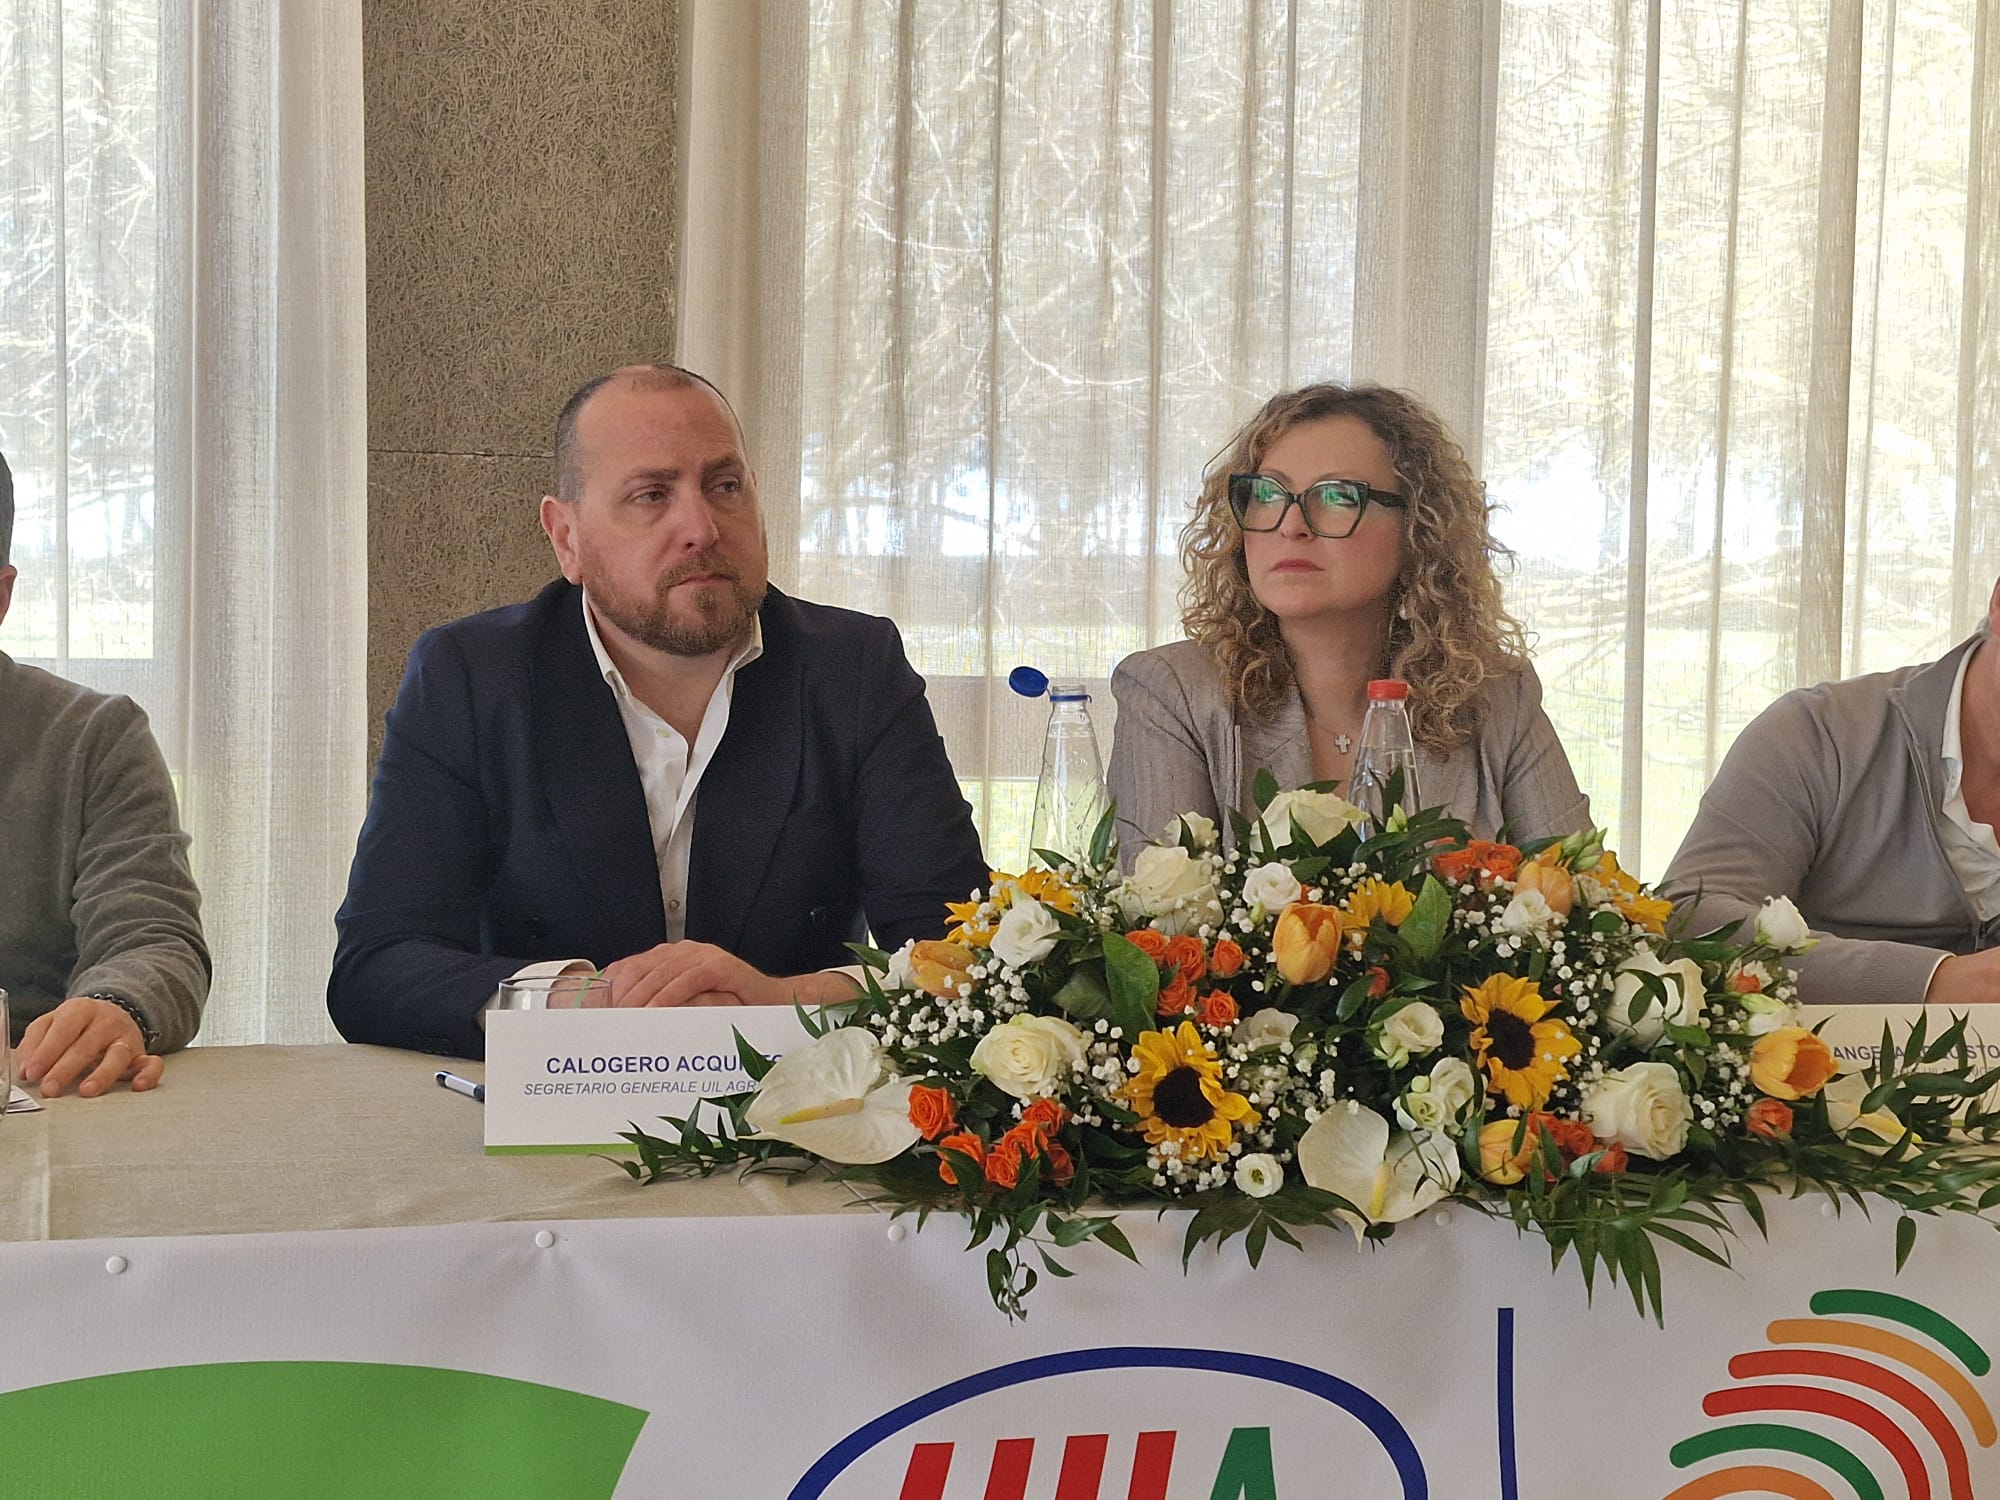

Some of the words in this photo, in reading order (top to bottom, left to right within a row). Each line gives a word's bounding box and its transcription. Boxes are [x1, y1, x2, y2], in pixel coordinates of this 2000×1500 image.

[1832, 1045, 1907, 1061] ANGEA
[546, 1056, 670, 1075] CALOGERO
[675, 1054, 783, 1073] ACQUI
[523, 1082, 616, 1096] SEGRETARIO
[620, 1081, 697, 1095] GENERALE
[701, 1081, 724, 1094] UIL
